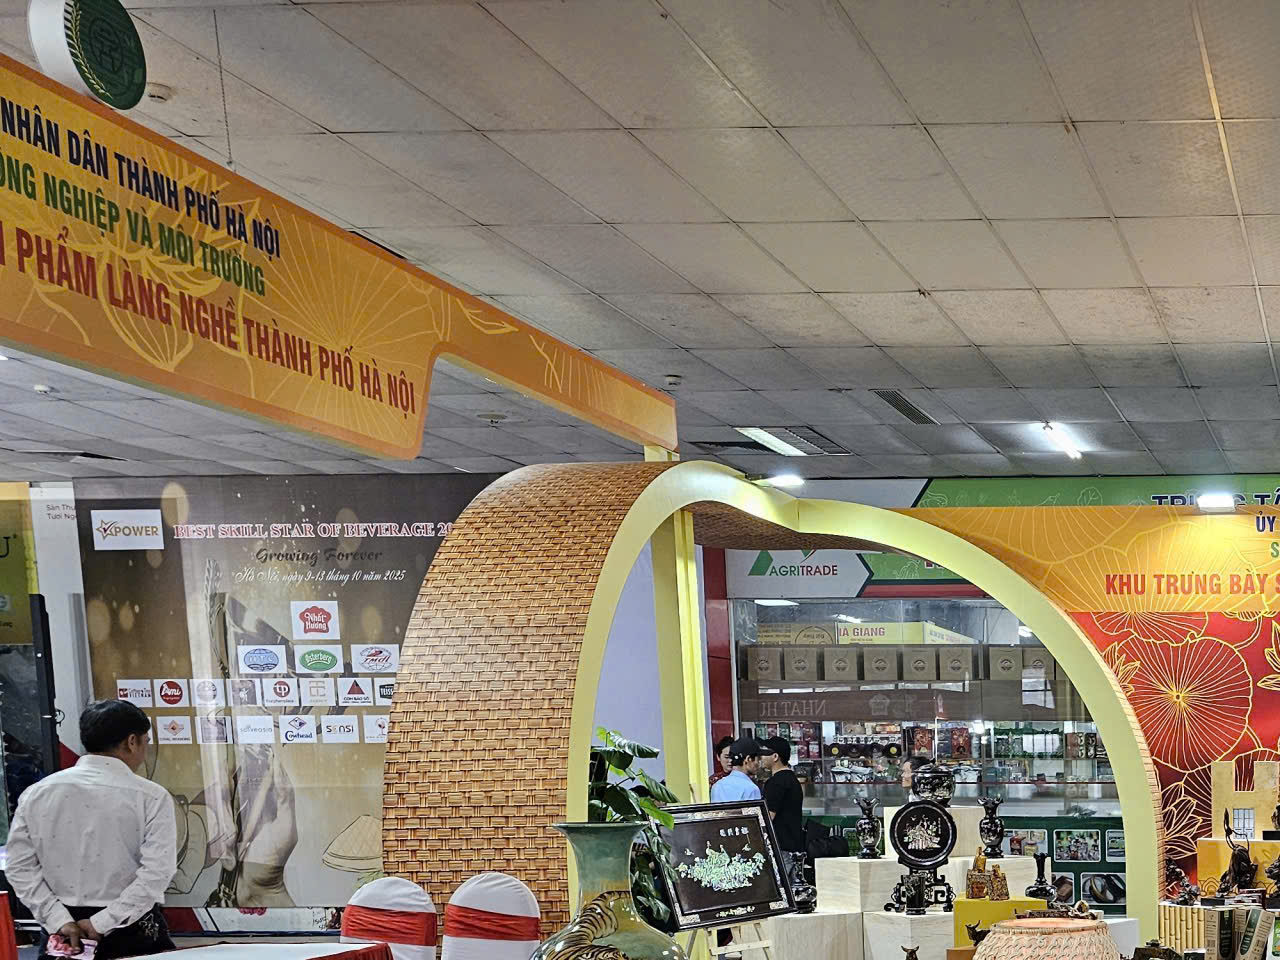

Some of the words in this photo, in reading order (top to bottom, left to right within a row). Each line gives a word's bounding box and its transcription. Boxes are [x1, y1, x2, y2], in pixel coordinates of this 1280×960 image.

[0, 96, 61, 158] NHÂN
[67, 128, 109, 180] DÂN
[114, 151, 179, 212] THÀNH
[185, 189, 220, 231] PHỐ
[226, 208, 248, 243] HÀ
[253, 219, 281, 259] NỘI
[43, 172, 120, 239] NGHIỆP
[126, 207, 154, 249] VÀ
[159, 223, 194, 267] MÔI
[199, 241, 266, 297] TRƯỜNG
[16, 226, 99, 301] PHẨM
[106, 257, 172, 326] LÀNG
[180, 294, 239, 350] NGHỀ
[244, 318, 312, 377] THÀNH
[319, 346, 354, 392] PHỐ
[360, 361, 383, 402] HÀ
[388, 370, 416, 419] NỘI
[173, 523, 216, 540] BEST
[218, 523, 268, 540] SKILL
[270, 522, 316, 538] STAR
[318, 522, 342, 538] OF
[343, 522, 435, 538] BEVERAGE
[1256, 511, 1275, 532] ỦY
[255, 548, 318, 566] Growing
[323, 548, 383, 562] Forever
[382, 569, 407, 582] 2025
[768, 564, 839, 577] AGRITRADE
[1105, 574, 1146, 596] KHU
[1153, 570, 1222, 596] TRƯNG
[1229, 568, 1268, 596] BÀY
